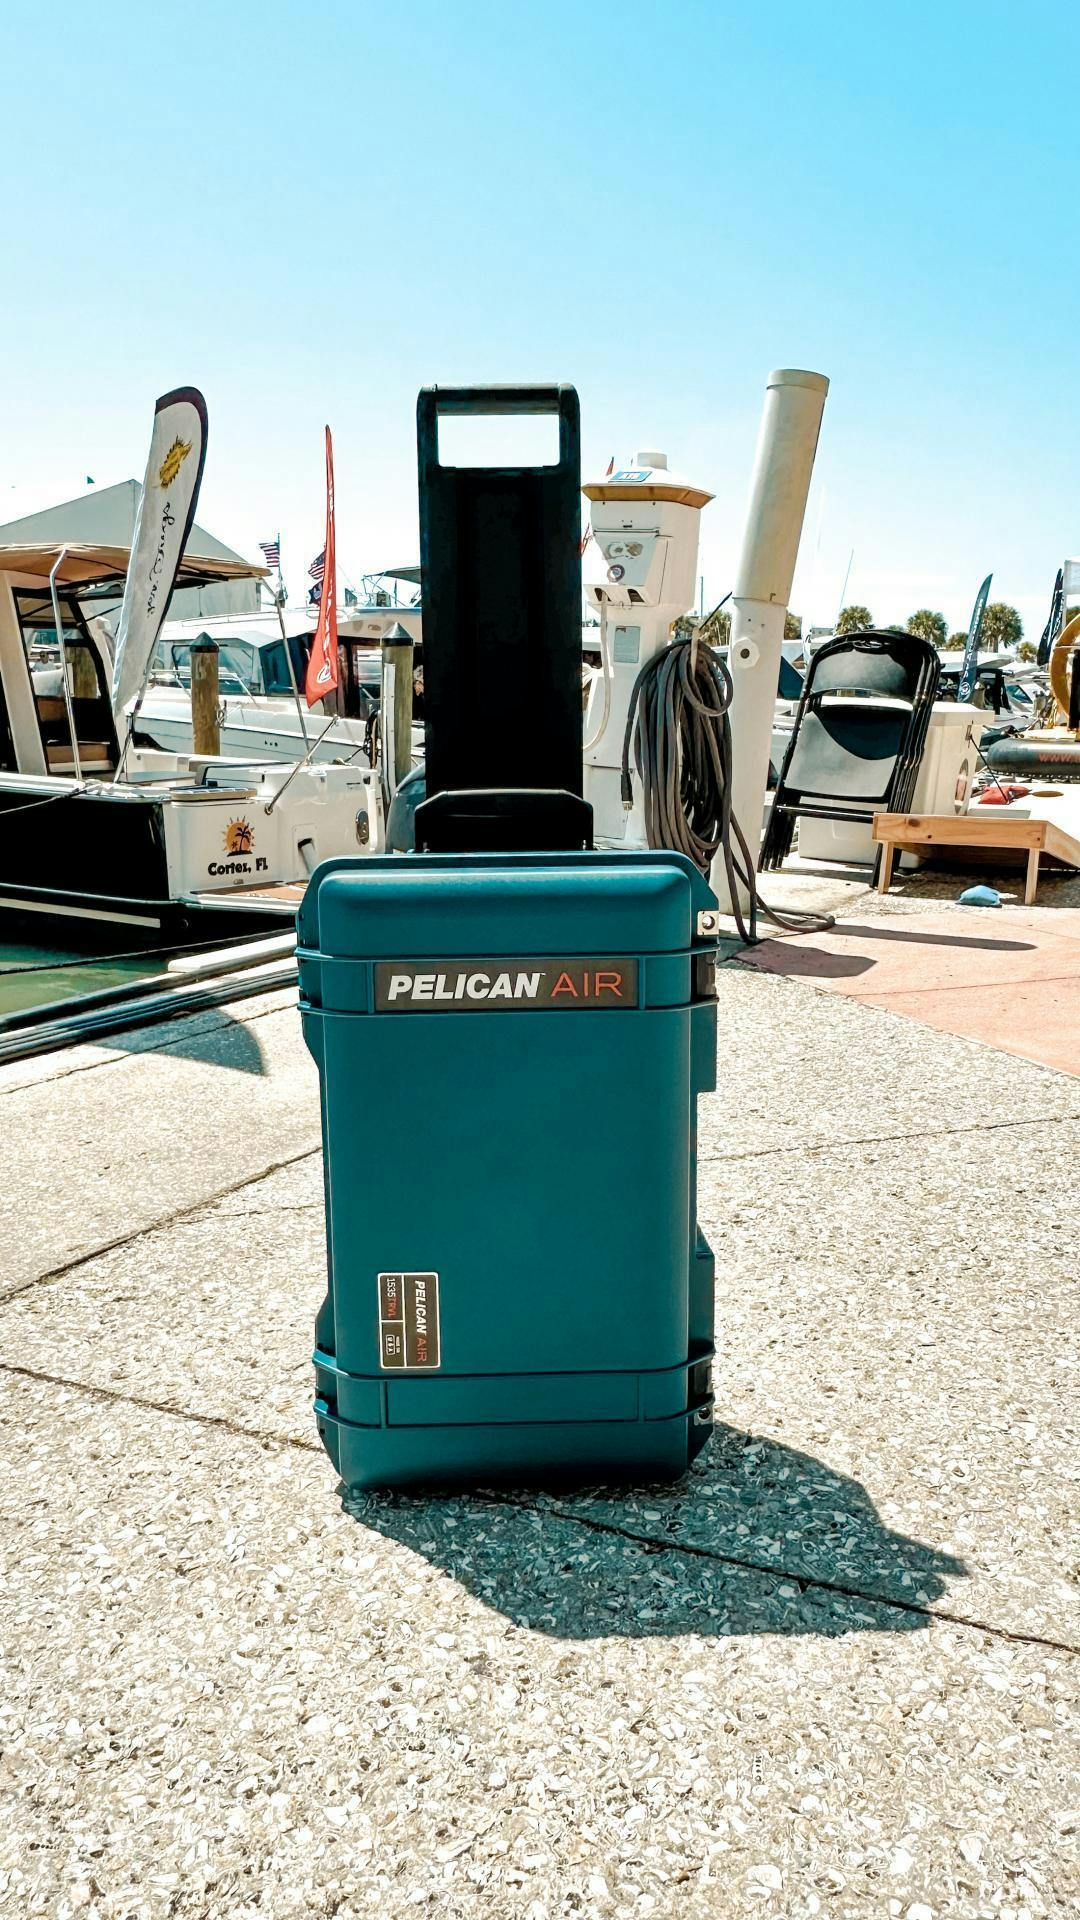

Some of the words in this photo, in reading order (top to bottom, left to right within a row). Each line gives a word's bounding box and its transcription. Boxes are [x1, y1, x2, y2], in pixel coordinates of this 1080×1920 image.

[208, 862, 252, 876] Cortez,
[255, 857, 268, 871] FL
[387, 972, 541, 1000] PELICAN
[551, 972, 623, 998] AIR
[415, 1280, 427, 1335] PELICAN
[417, 1337, 427, 1362] AIR
